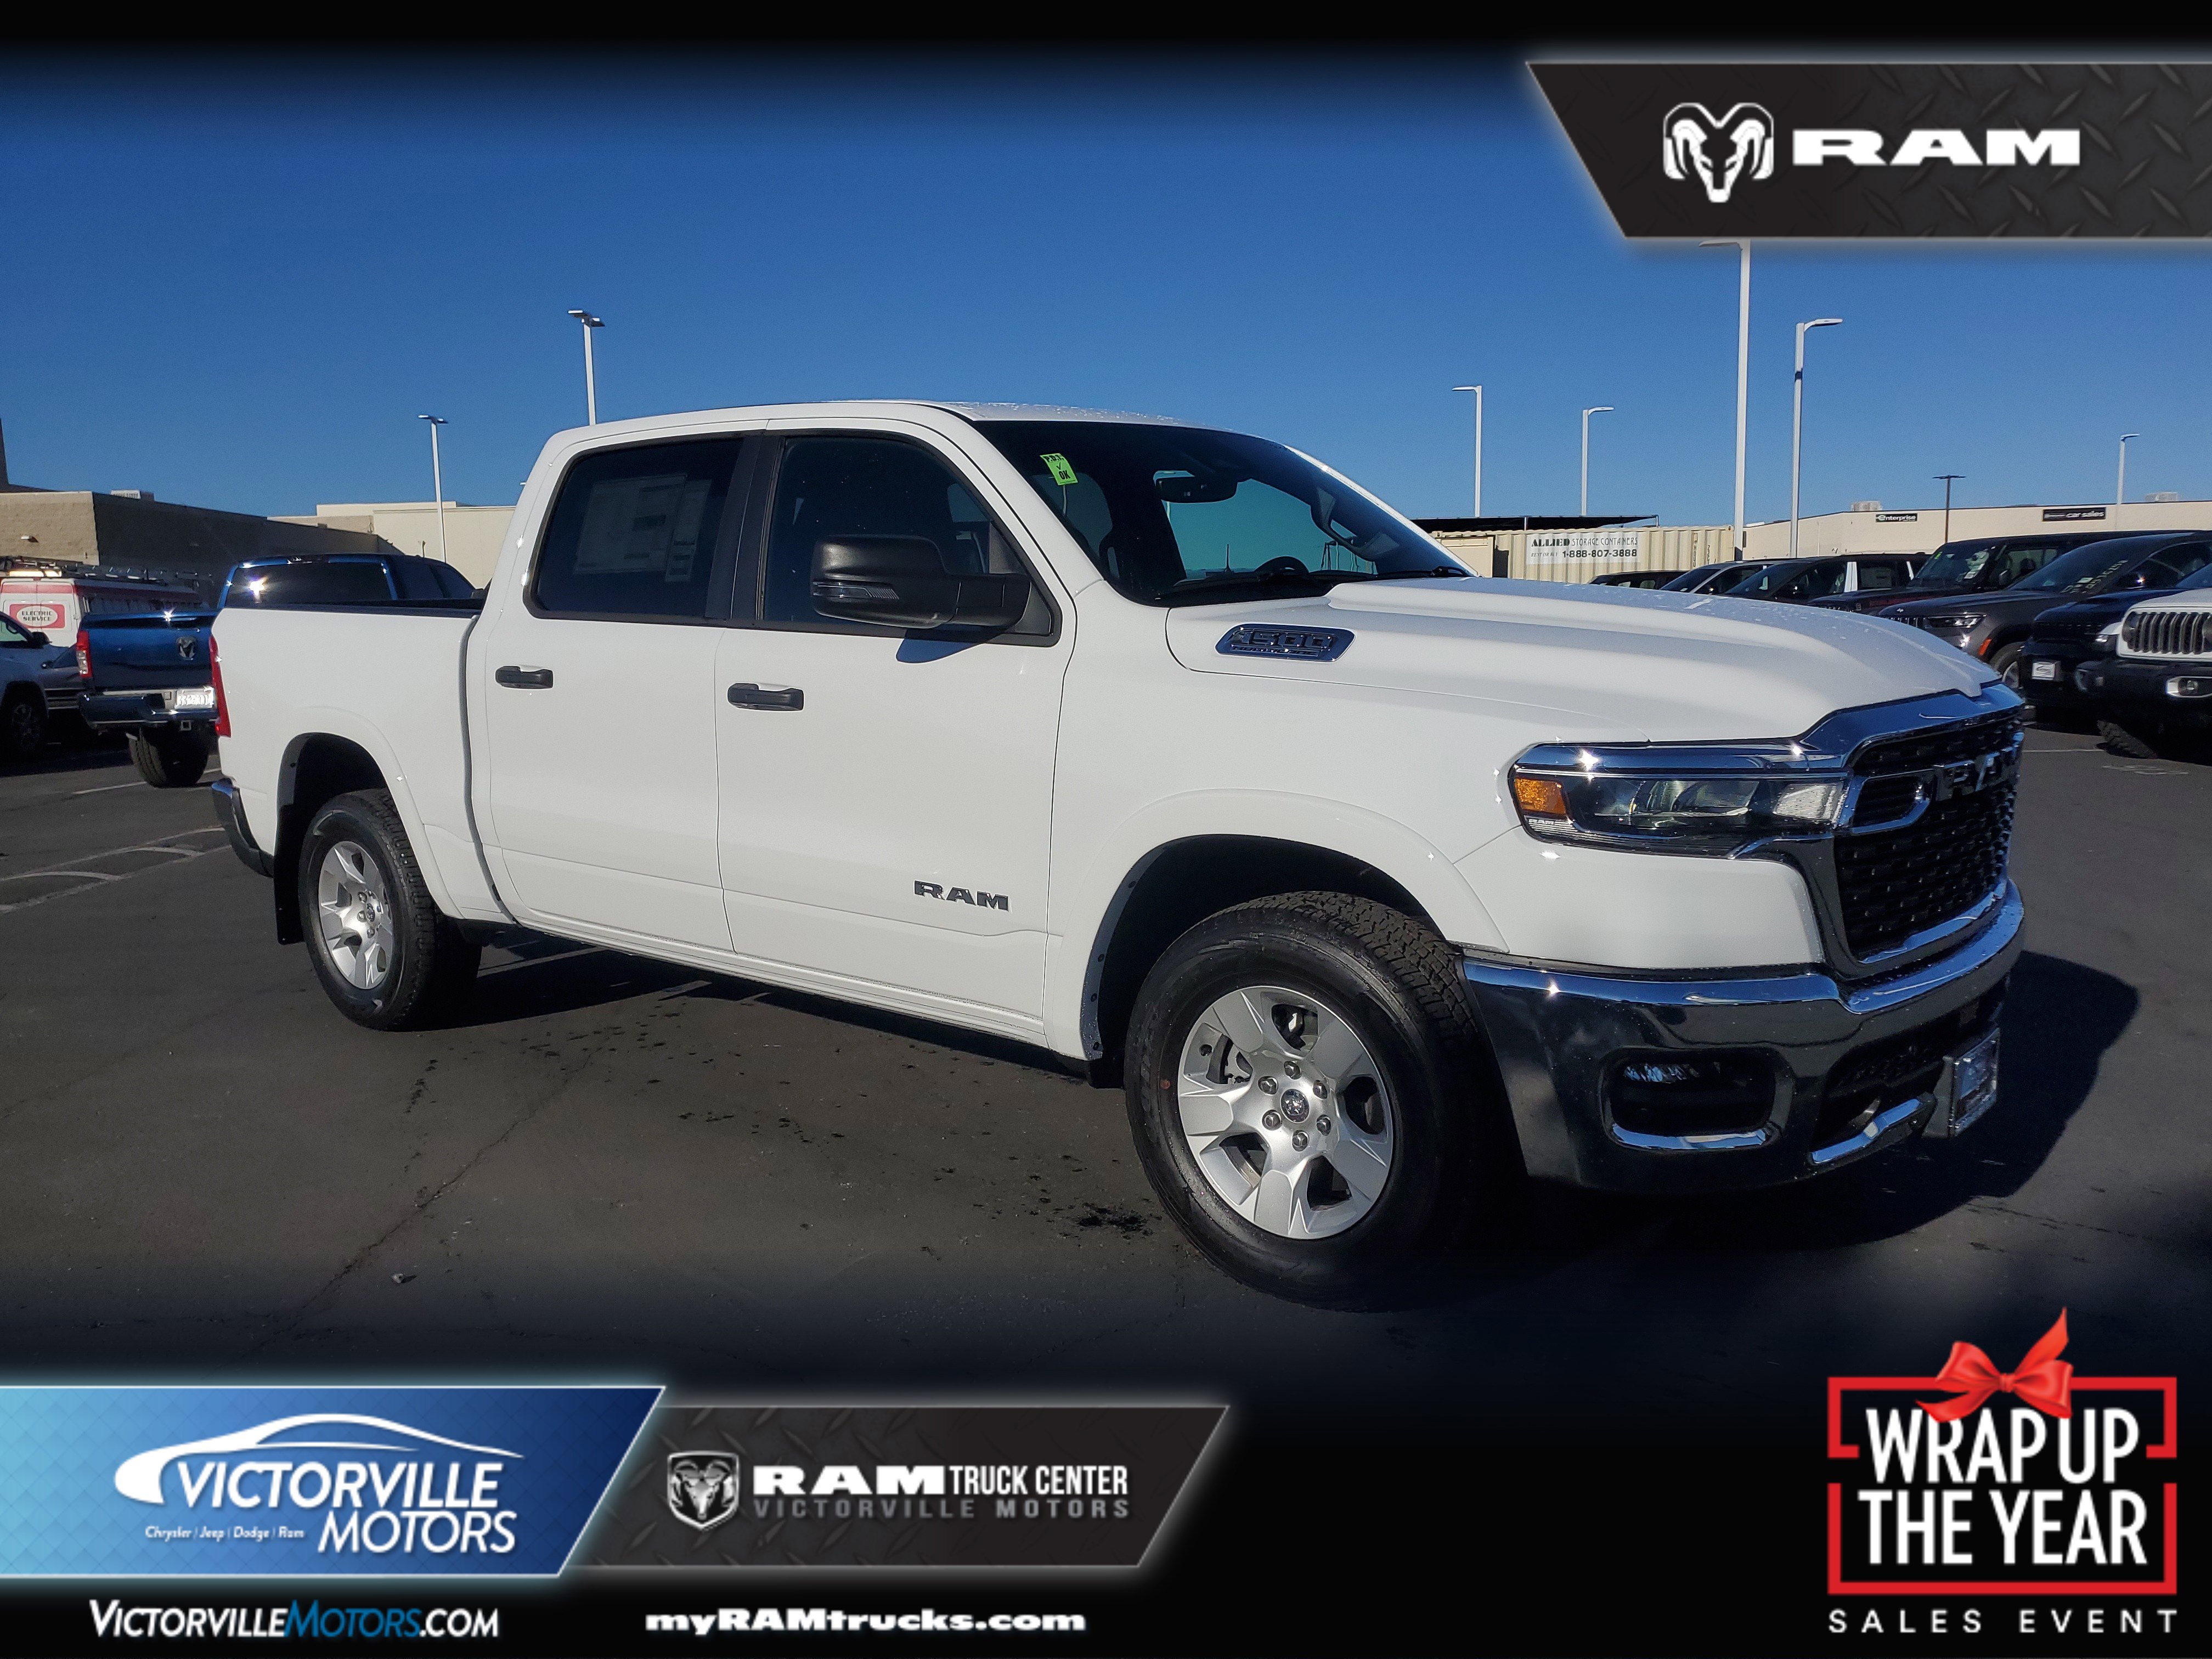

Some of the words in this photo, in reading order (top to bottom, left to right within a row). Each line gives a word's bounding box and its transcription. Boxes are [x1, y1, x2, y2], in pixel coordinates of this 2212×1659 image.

[1058, 470, 1071, 480] OK
[1531, 538, 1570, 547] ALLIED
[1571, 538, 1599, 546] STORAGE
[1600, 537, 1638, 546] CONTAINERS
[1562, 549, 1637, 558] 1-888-807-3888
[914, 880, 1009, 912] RAM
